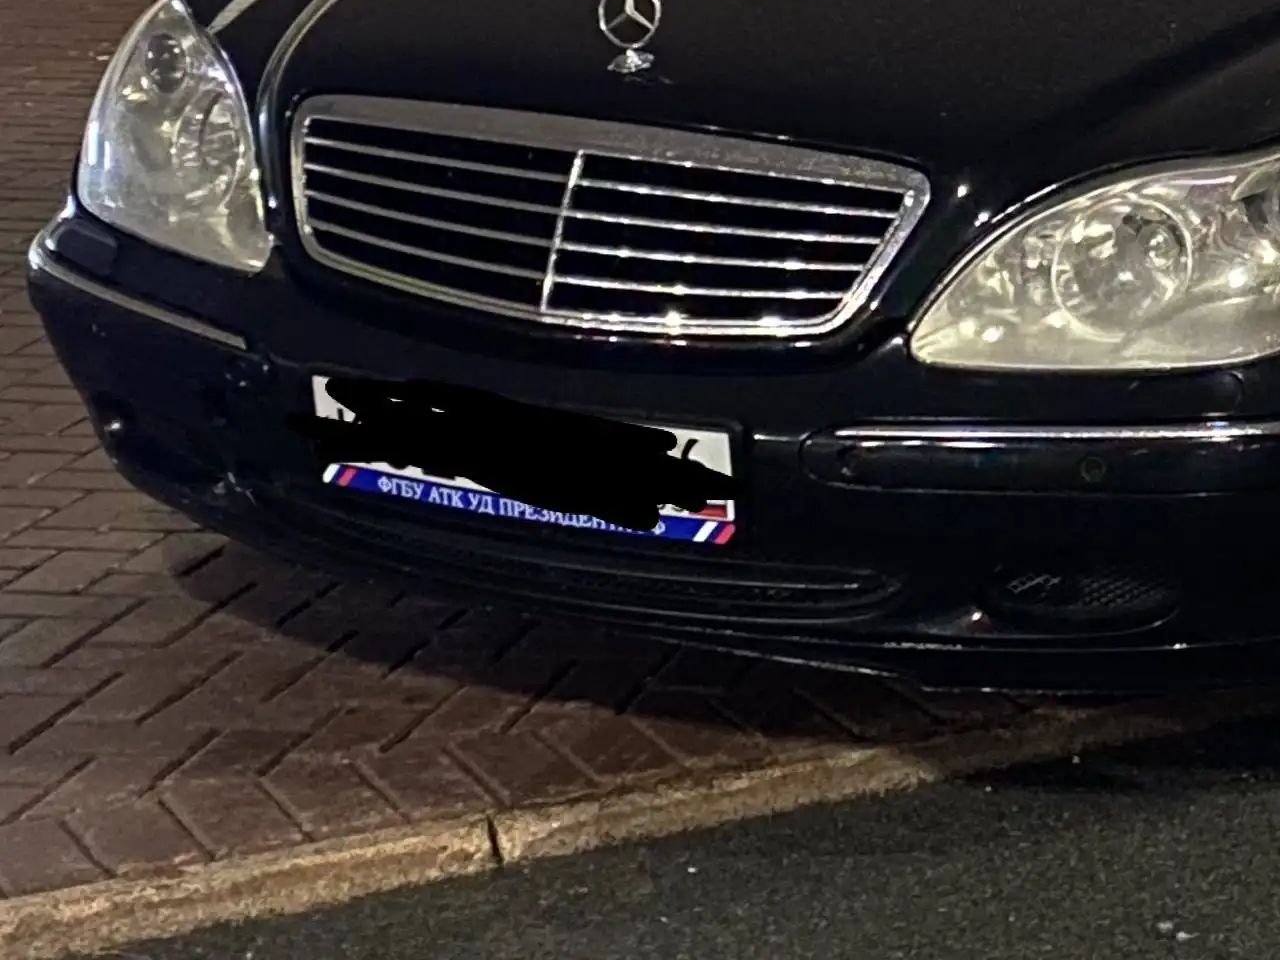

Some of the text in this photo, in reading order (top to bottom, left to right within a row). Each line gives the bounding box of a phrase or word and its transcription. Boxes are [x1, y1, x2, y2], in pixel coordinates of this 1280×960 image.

[377, 475, 424, 500] ФГБУ
[428, 486, 465, 509] АТК
[467, 493, 496, 515] УД
[499, 497, 633, 533] ПРЕЗИДЕН
